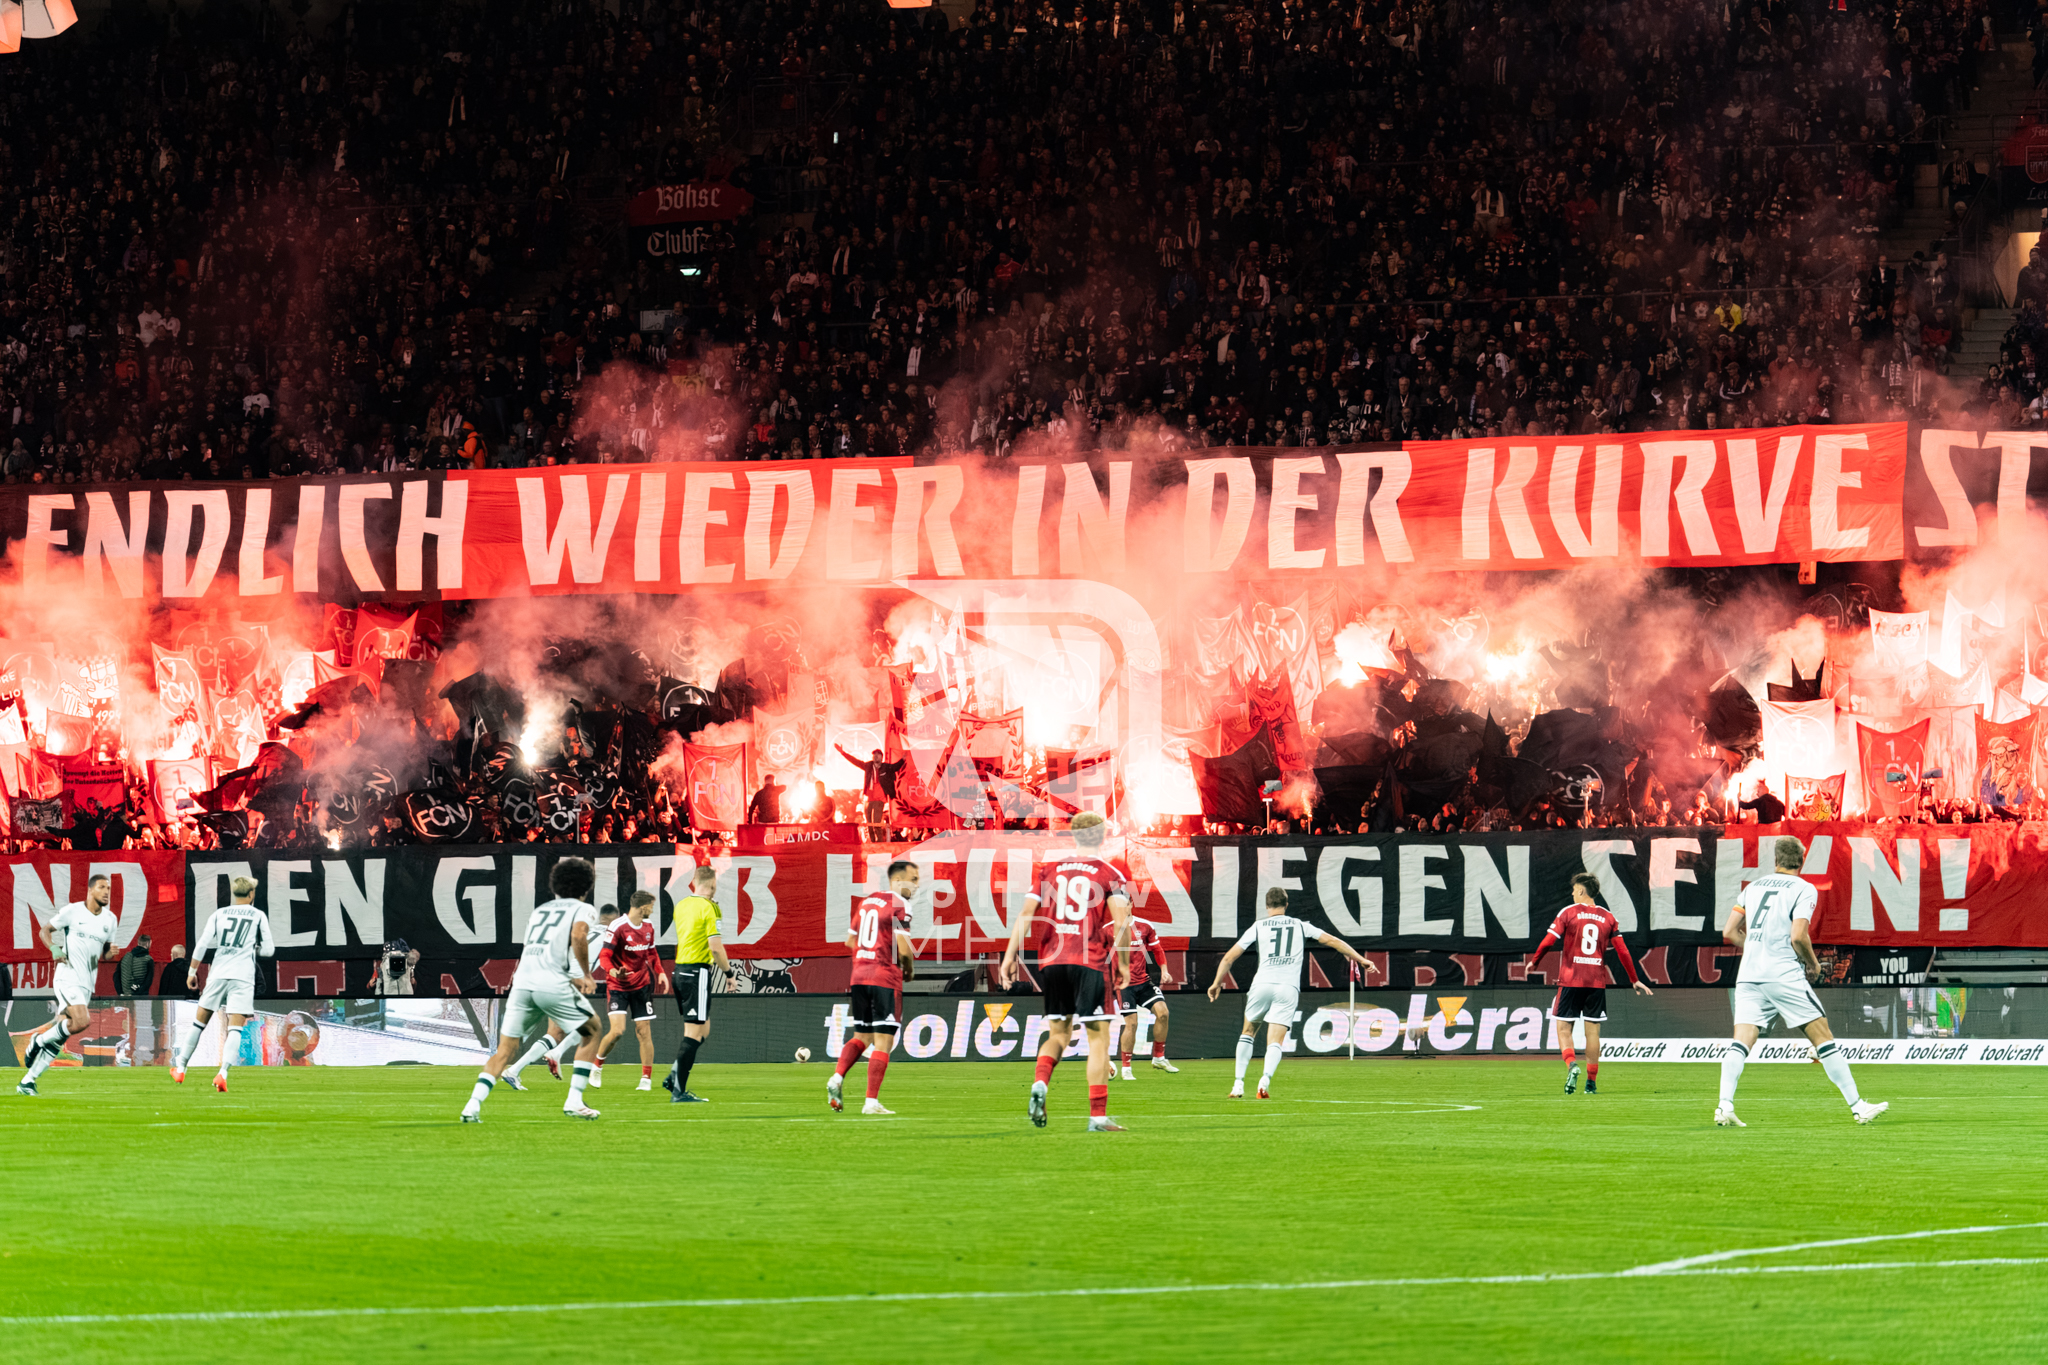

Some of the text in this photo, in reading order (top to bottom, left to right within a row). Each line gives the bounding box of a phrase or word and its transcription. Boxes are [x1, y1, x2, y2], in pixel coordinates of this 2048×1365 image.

[23, 479, 469, 598] ENDLICH
[516, 465, 965, 586] WIEDER
[1011, 460, 1132, 576] IN
[1184, 450, 1415, 573] DER
[1461, 433, 1872, 560] KURVE
[158, 679, 196, 703] FCN
[769, 742, 795, 756] FCN
[1884, 739, 1902, 761] 1.
[173, 768, 187, 786] 1.
[708, 759, 719, 781] 1.
[693, 782, 737, 806] FCN
[416, 802, 468, 833] FCN
[190, 858, 388, 948] DEN
[1143, 845, 1530, 938] SIEGEN
[1056, 874, 1091, 921] 19
[1749, 890, 1780, 930] 6
[220, 917, 254, 949] 20
[527, 910, 566, 945] 22
[857, 908, 879, 949] 10
[1580, 923, 1600, 956] 8
[1268, 926, 1295, 958] 31
[1880, 956, 1909, 974] YOU
[645, 1001, 654, 1015] 6
[1600, 1042, 1667, 1058] toolcraft
[1905, 1043, 1969, 1060] toolcraft
[1979, 1044, 2045, 1061] toolcraft
